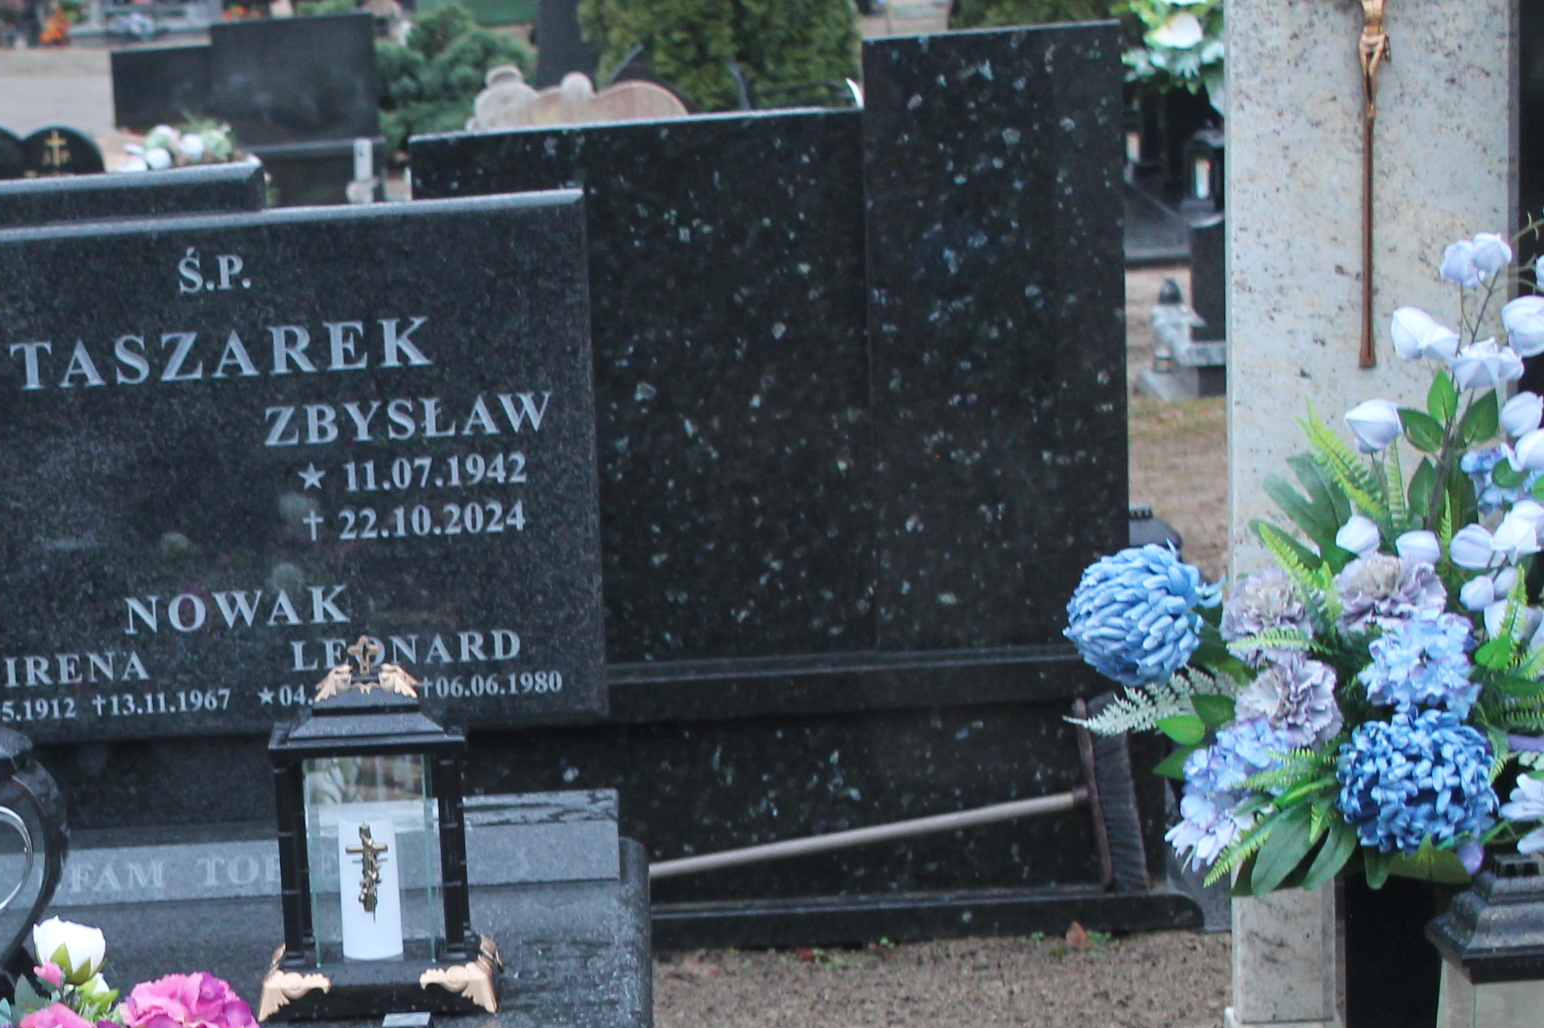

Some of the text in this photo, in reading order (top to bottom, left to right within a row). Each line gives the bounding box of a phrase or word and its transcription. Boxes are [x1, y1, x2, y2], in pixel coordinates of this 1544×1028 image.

[177, 247, 252, 293] Ś.P.
[9, 315, 433, 391] TASZAREK
[264, 390, 553, 447] ZBYSŁAW
[343, 449, 528, 493] 11.07.1942
[338, 499, 527, 542] 22.10.2024
[123, 583, 352, 635] NOWAK
[4, 648, 151, 688] IRENA
[290, 628, 521, 672] LEONARD
[109, 687, 232, 717] 13.11.1967
[435, 671, 564, 699] 06.06.1980
[39, 857, 165, 895] FAM
